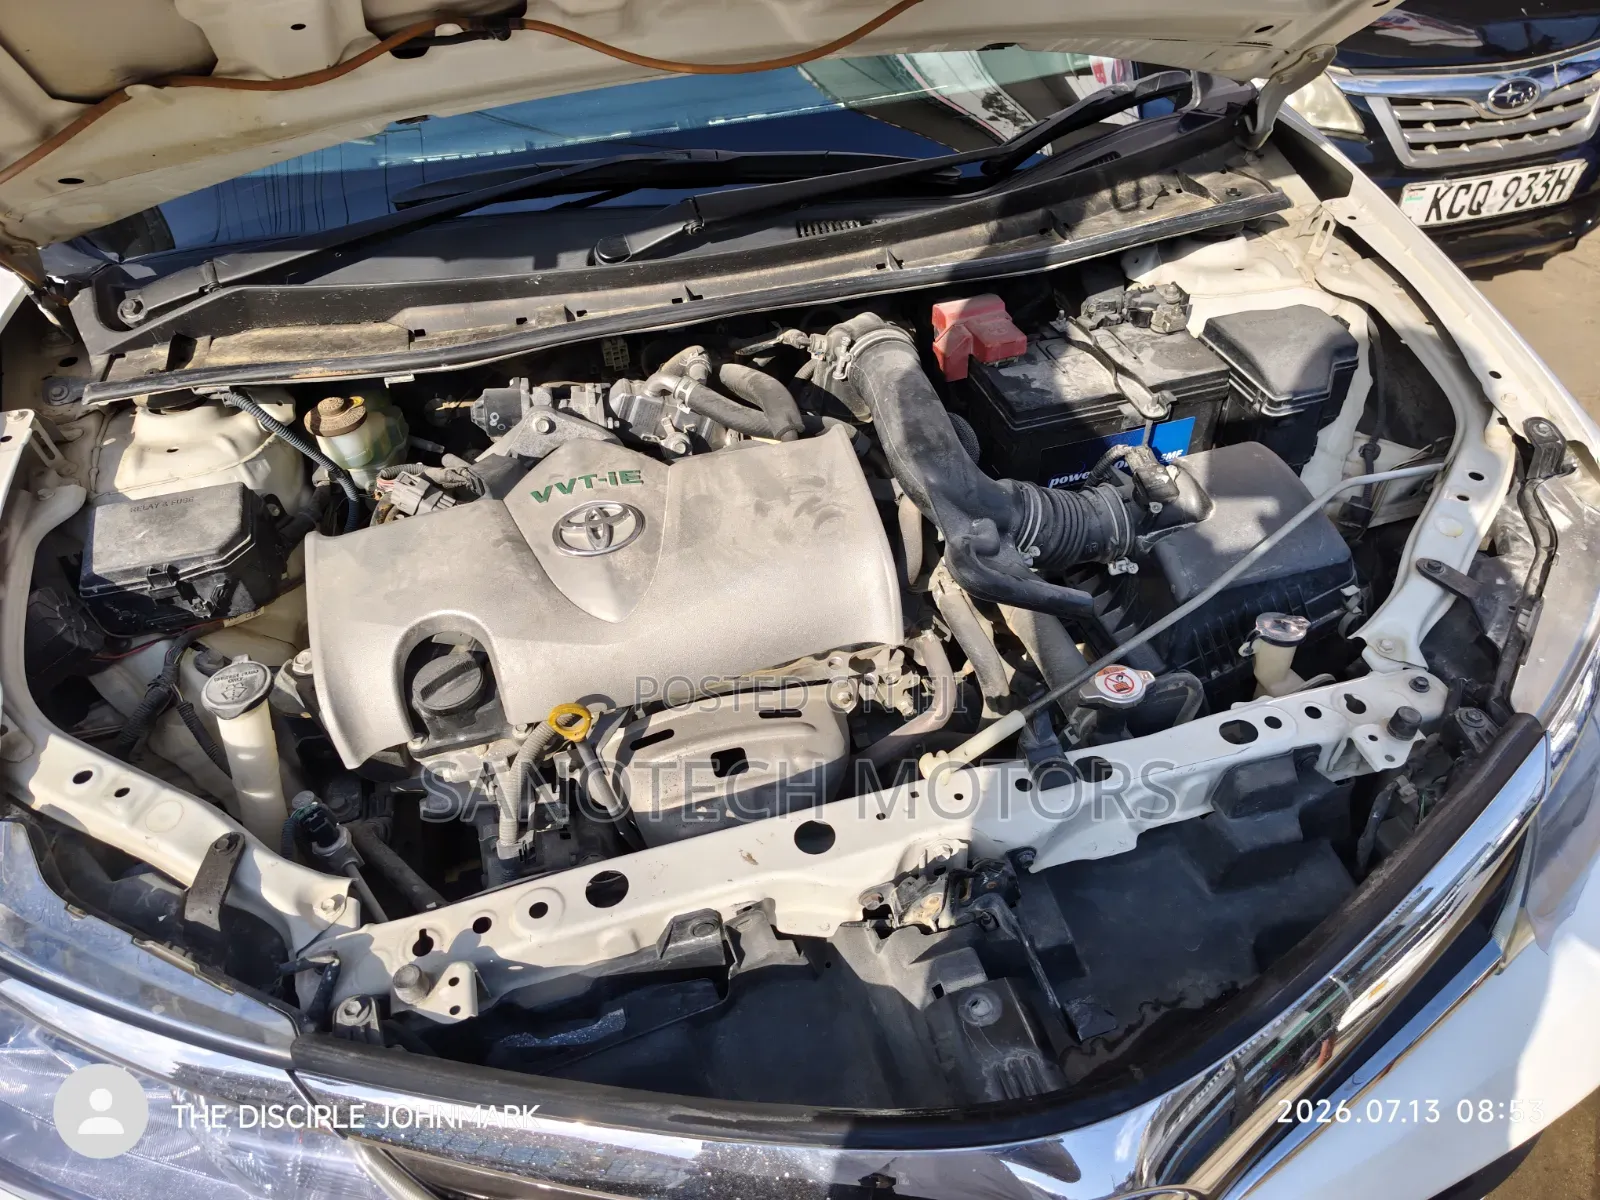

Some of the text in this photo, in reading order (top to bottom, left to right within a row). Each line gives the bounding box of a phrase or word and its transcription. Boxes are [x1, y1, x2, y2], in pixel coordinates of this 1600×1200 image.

[1425, 165, 1576, 222] KCQ 933H
[1161, 449, 1184, 461] SMF
[1049, 471, 1090, 488] powe
[130, 503, 159, 513] RELAY
[171, 496, 194, 506] FUSE
